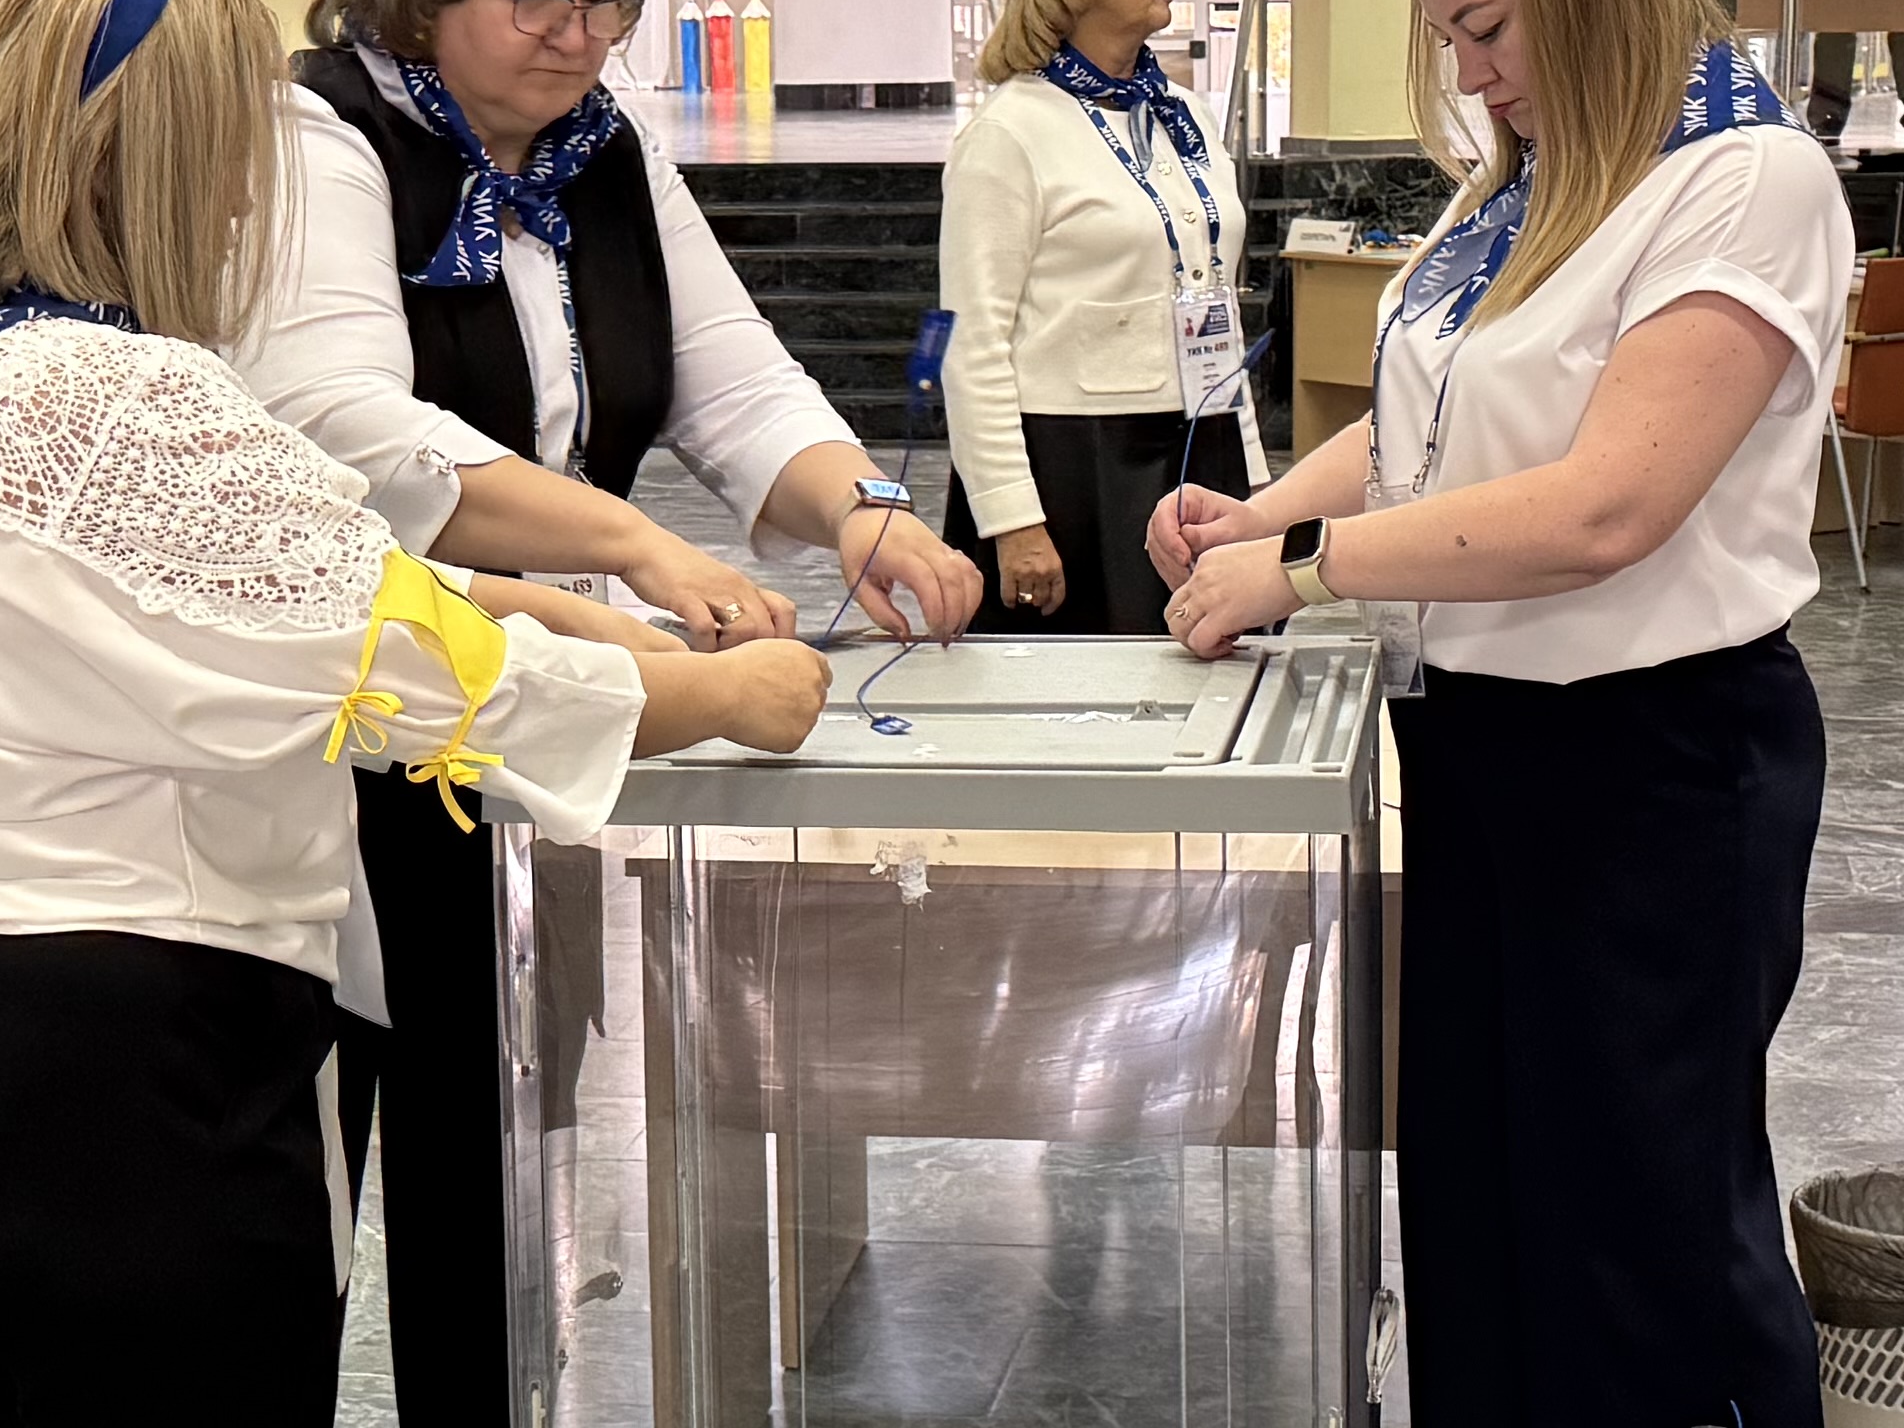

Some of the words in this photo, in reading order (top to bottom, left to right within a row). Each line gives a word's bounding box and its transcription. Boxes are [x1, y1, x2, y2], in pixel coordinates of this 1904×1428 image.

[1682, 96, 1708, 136] УИК
[472, 186, 498, 241] УИК
[1202, 195, 1220, 224] УИК
